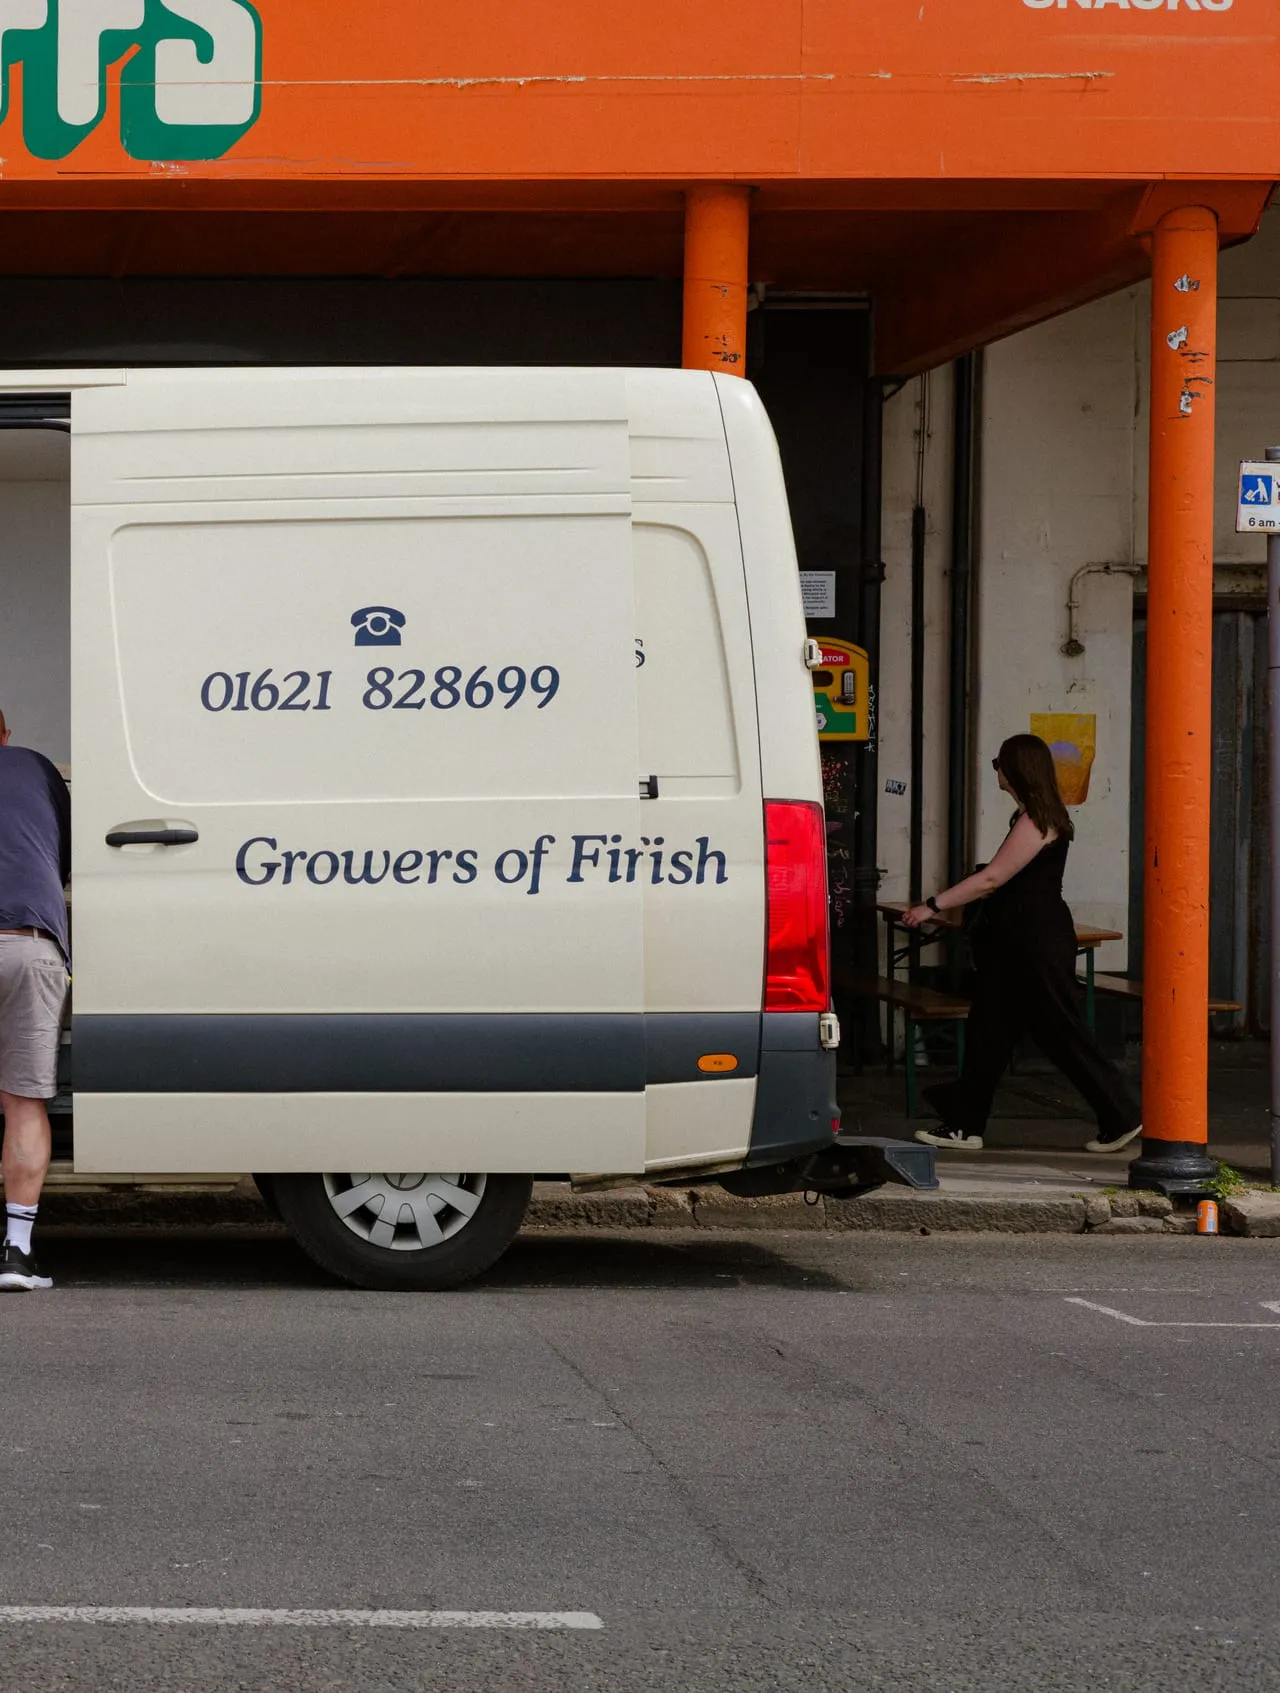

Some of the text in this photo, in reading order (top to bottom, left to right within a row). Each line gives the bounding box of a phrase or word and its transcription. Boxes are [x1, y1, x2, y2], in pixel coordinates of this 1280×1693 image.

[1248, 517, 1276, 527] 6 am
[200, 665, 560, 712] 01621 828699
[235, 836, 478, 886] Growers
[494, 834, 556, 896] of
